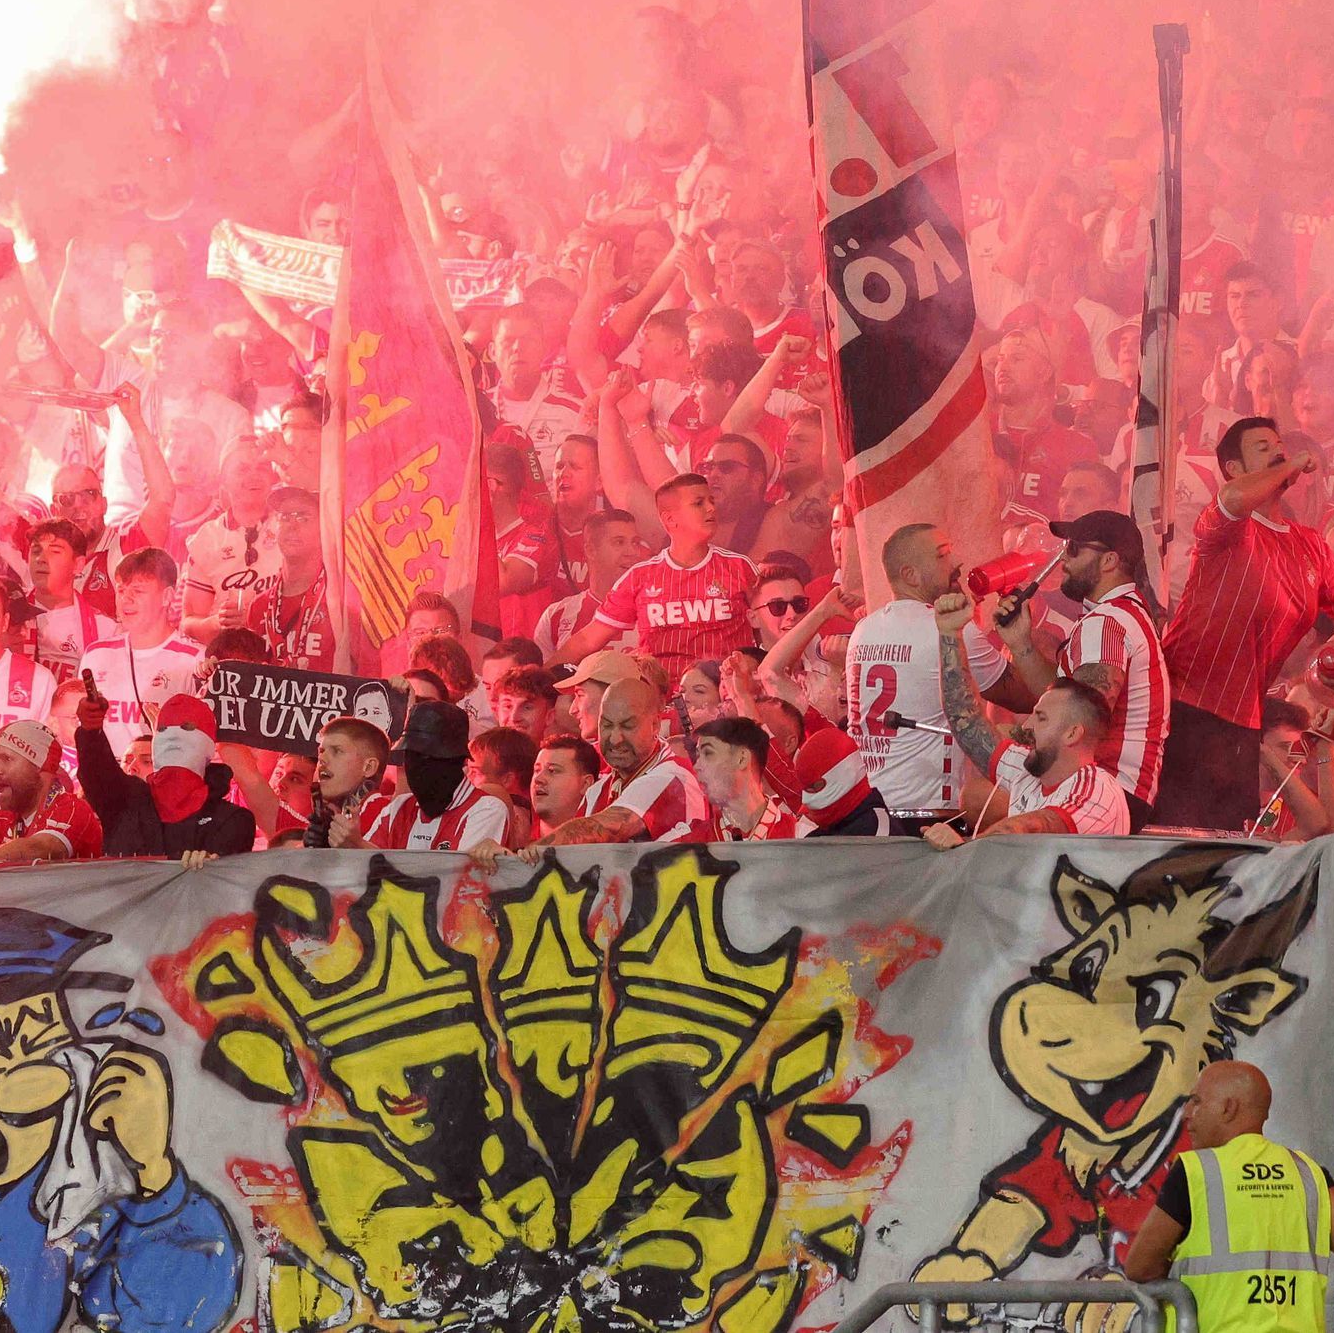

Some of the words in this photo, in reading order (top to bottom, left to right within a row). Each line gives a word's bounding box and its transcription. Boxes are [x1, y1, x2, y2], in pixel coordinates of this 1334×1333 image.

[647, 598, 732, 627] REWE
[250, 674, 348, 711] IMMER
[7, 733, 38, 759] Köln
[1242, 1163, 1285, 1180] SDS
[1247, 1273, 1297, 1306] 2851
